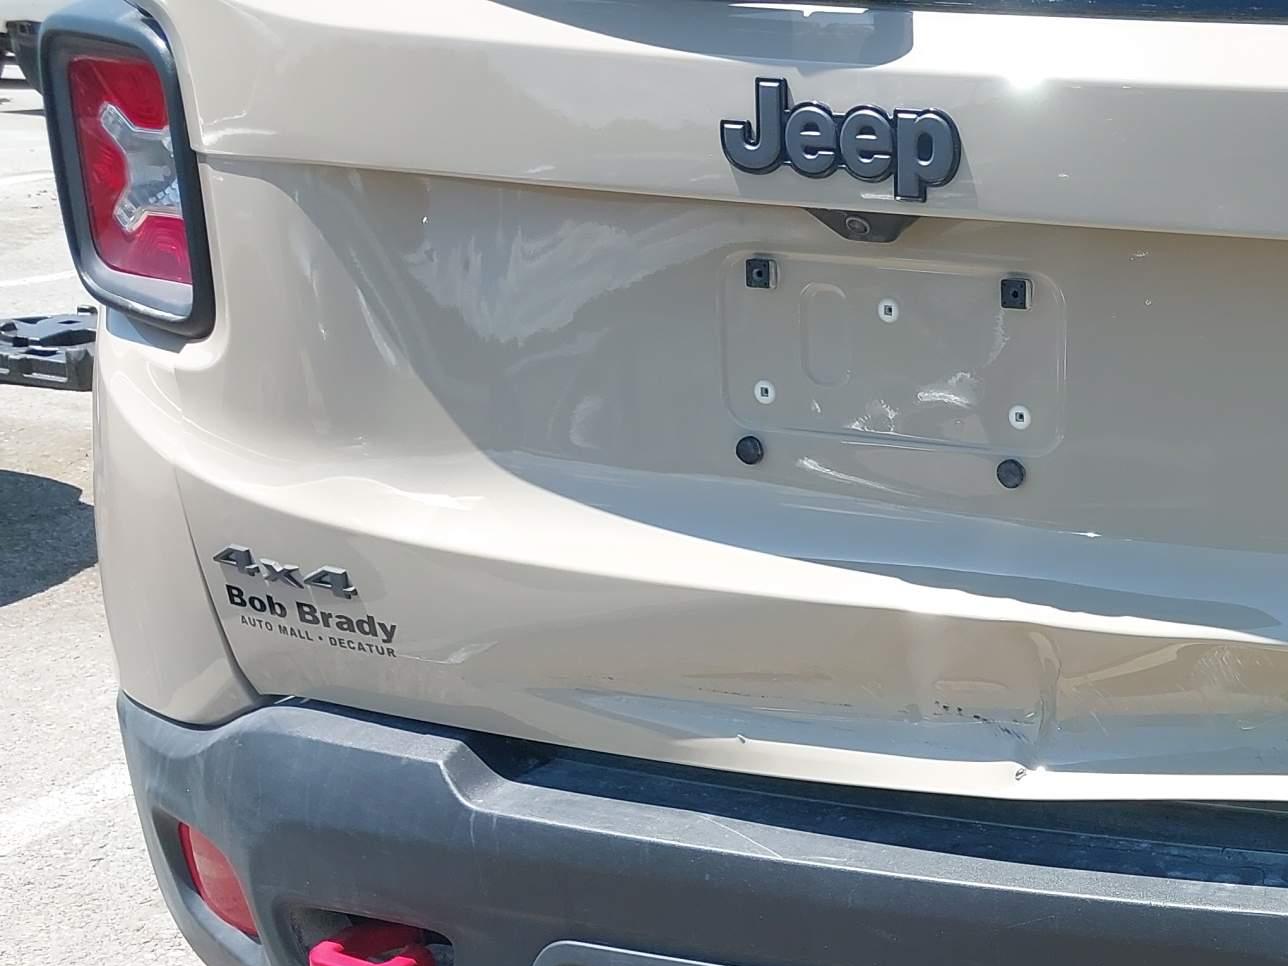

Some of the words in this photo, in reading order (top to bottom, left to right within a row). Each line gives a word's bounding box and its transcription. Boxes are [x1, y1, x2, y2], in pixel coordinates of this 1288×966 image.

[720, 77, 962, 203] Jeep
[213, 543, 359, 600] 4x4
[225, 584, 288, 619] Bob
[296, 600, 397, 644] Brady
[241, 615, 274, 632] AUTO
[278, 624, 314, 642] MALL
[328, 636, 397, 658] DECATUR
